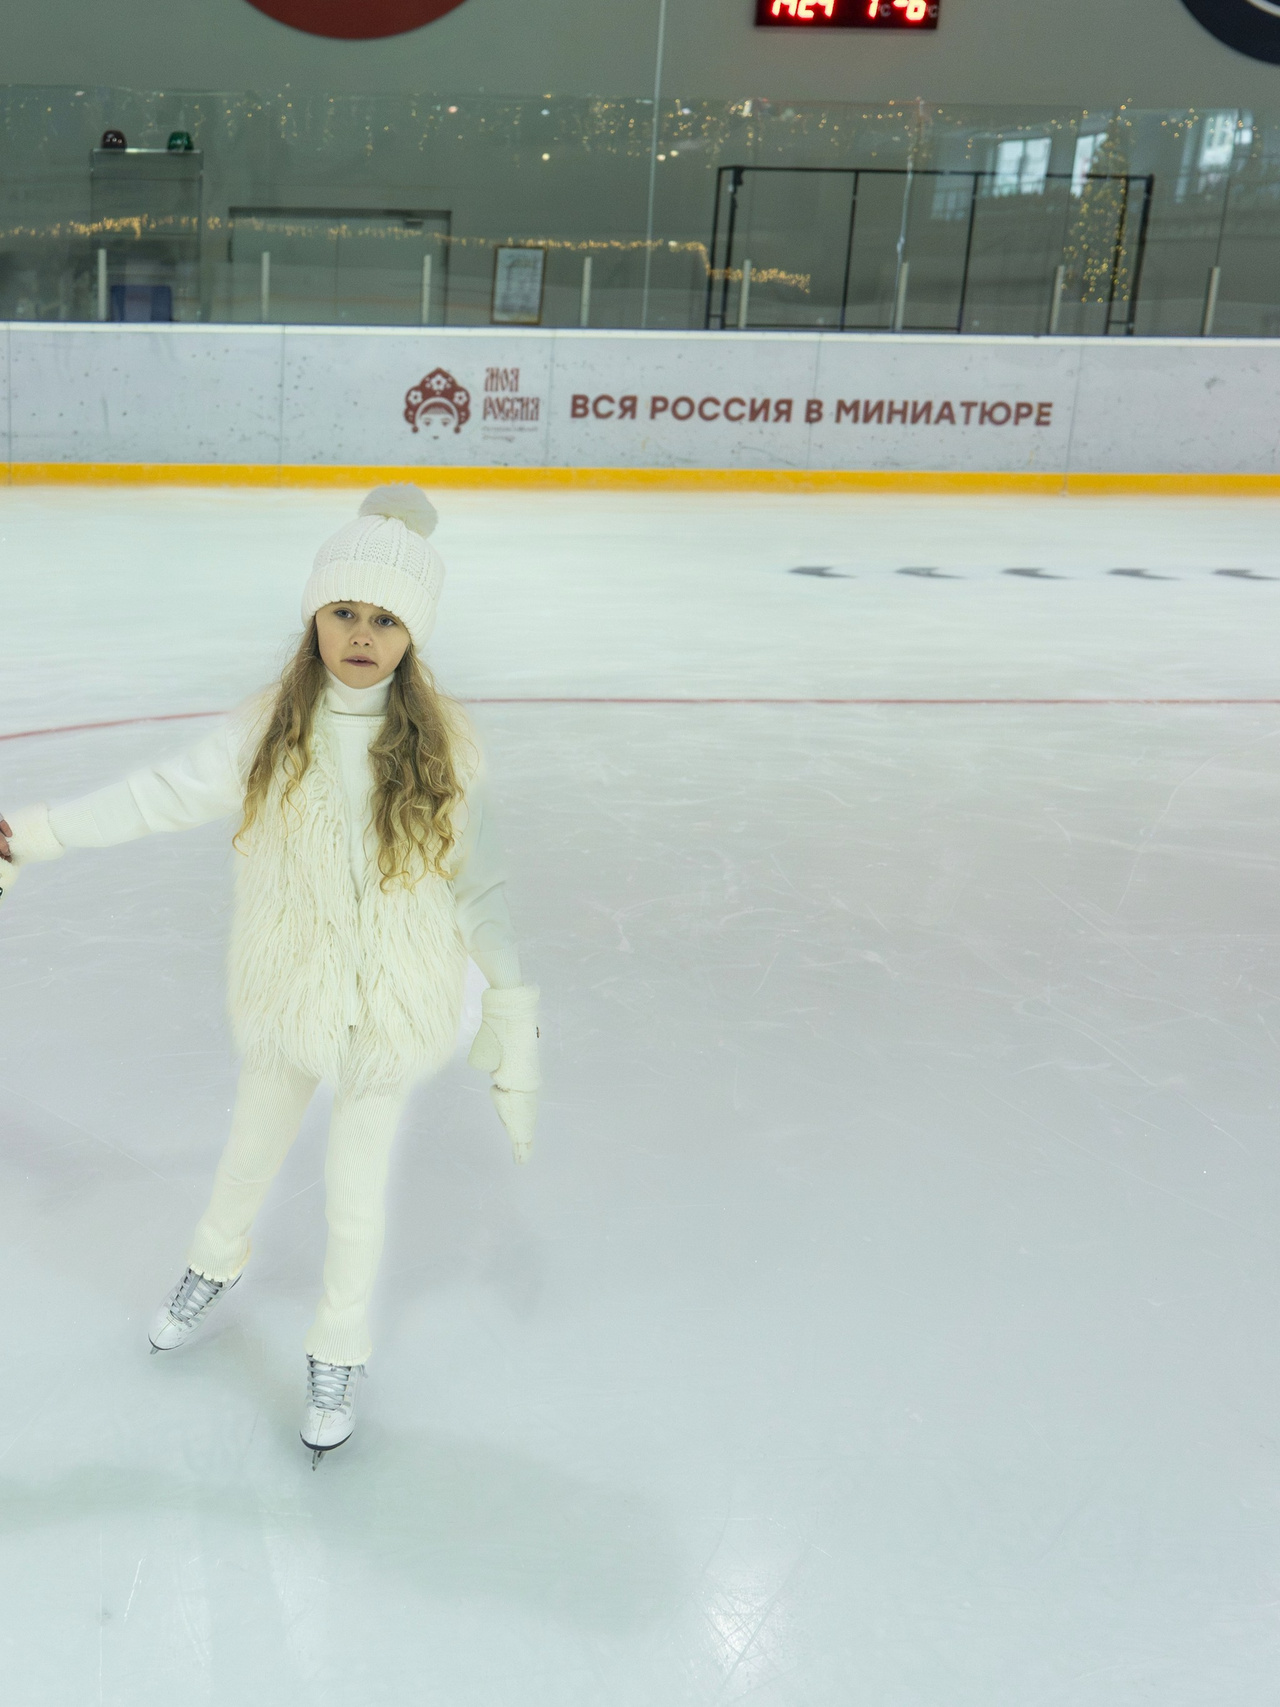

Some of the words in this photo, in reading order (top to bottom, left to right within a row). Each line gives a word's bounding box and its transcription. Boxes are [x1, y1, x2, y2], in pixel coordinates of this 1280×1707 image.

[569, 394, 638, 420] ВСЯ
[648, 395, 793, 423] РОССИЯ
[804, 398, 823, 424] В
[834, 399, 1054, 427] МИНИАТЮРЕ
